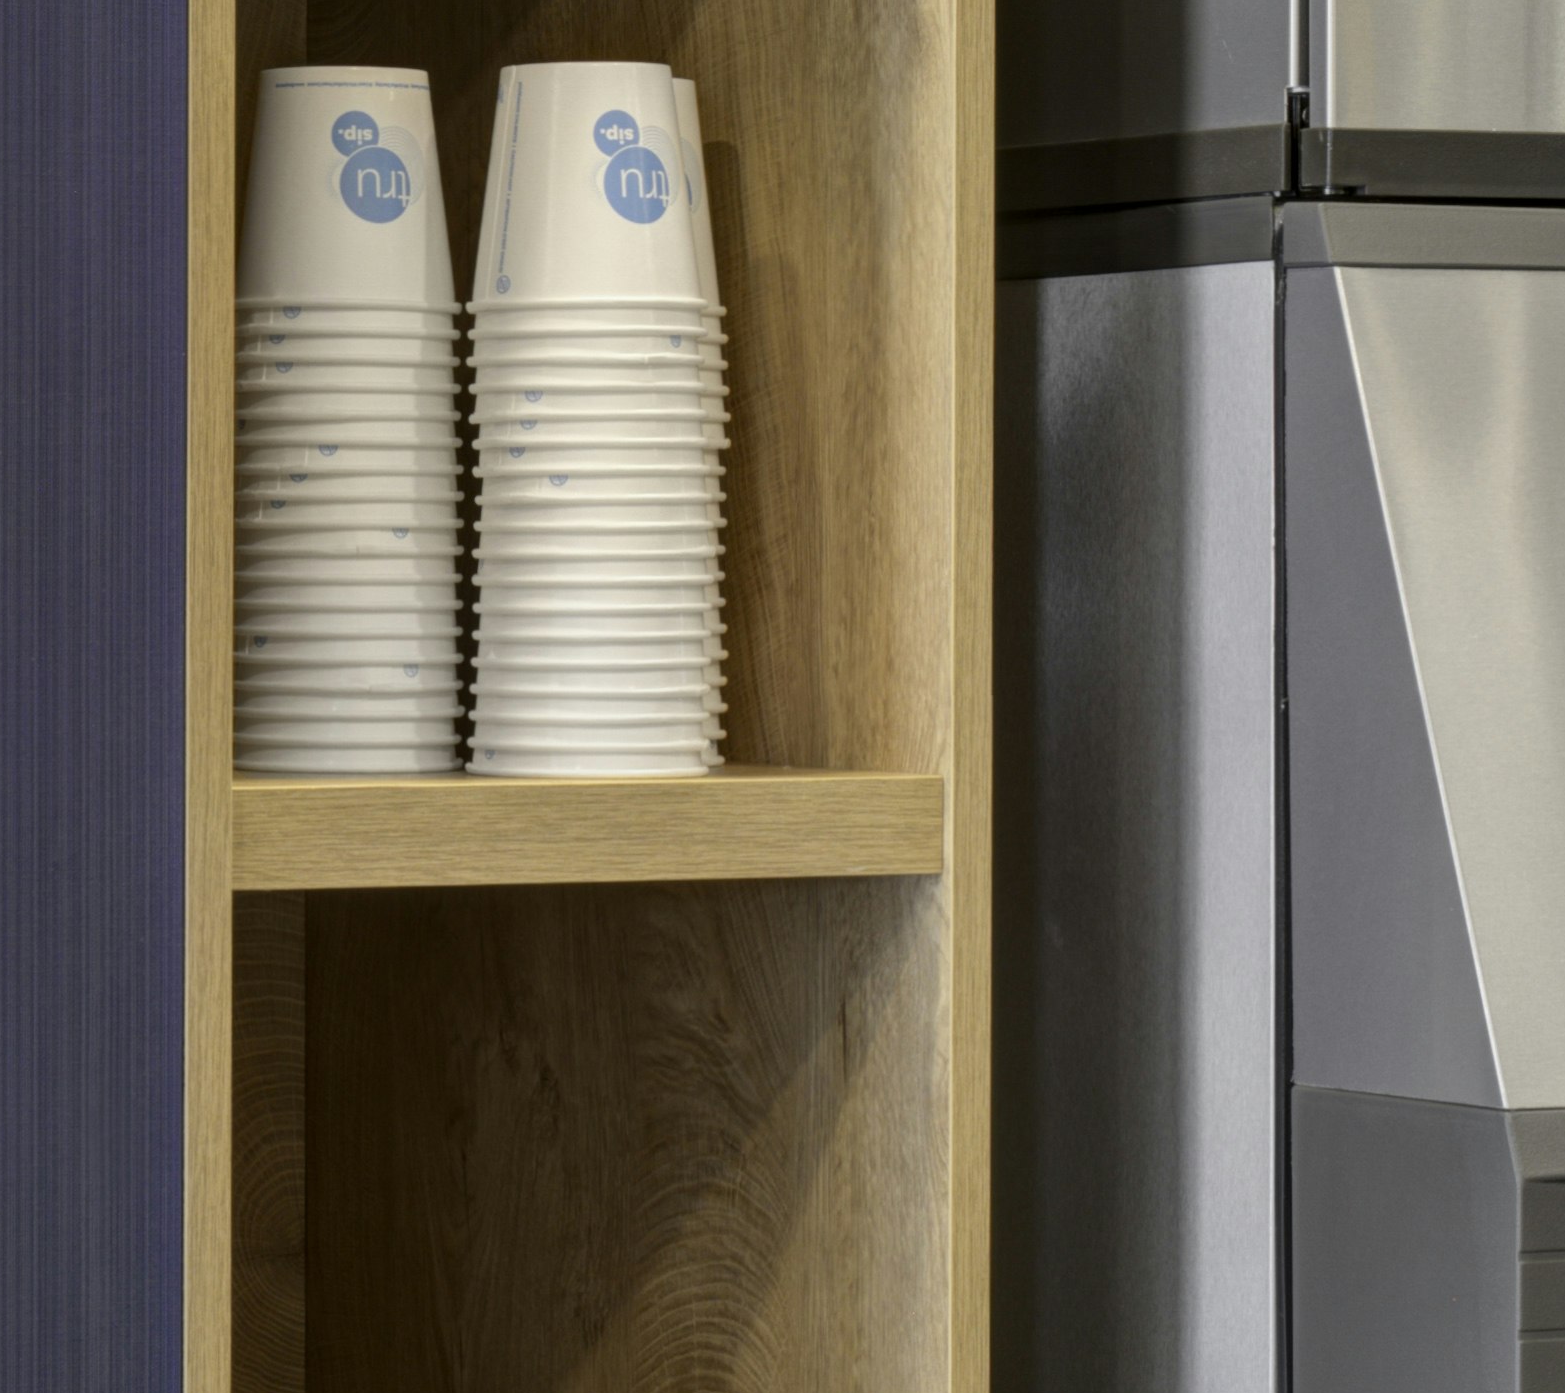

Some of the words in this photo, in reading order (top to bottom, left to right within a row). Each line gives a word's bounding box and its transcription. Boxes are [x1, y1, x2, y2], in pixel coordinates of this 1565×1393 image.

[338, 124, 373, 145] sip.
[600, 124, 634, 145] sip.
[357, 168, 410, 208] tru
[620, 168, 670, 208] tru
